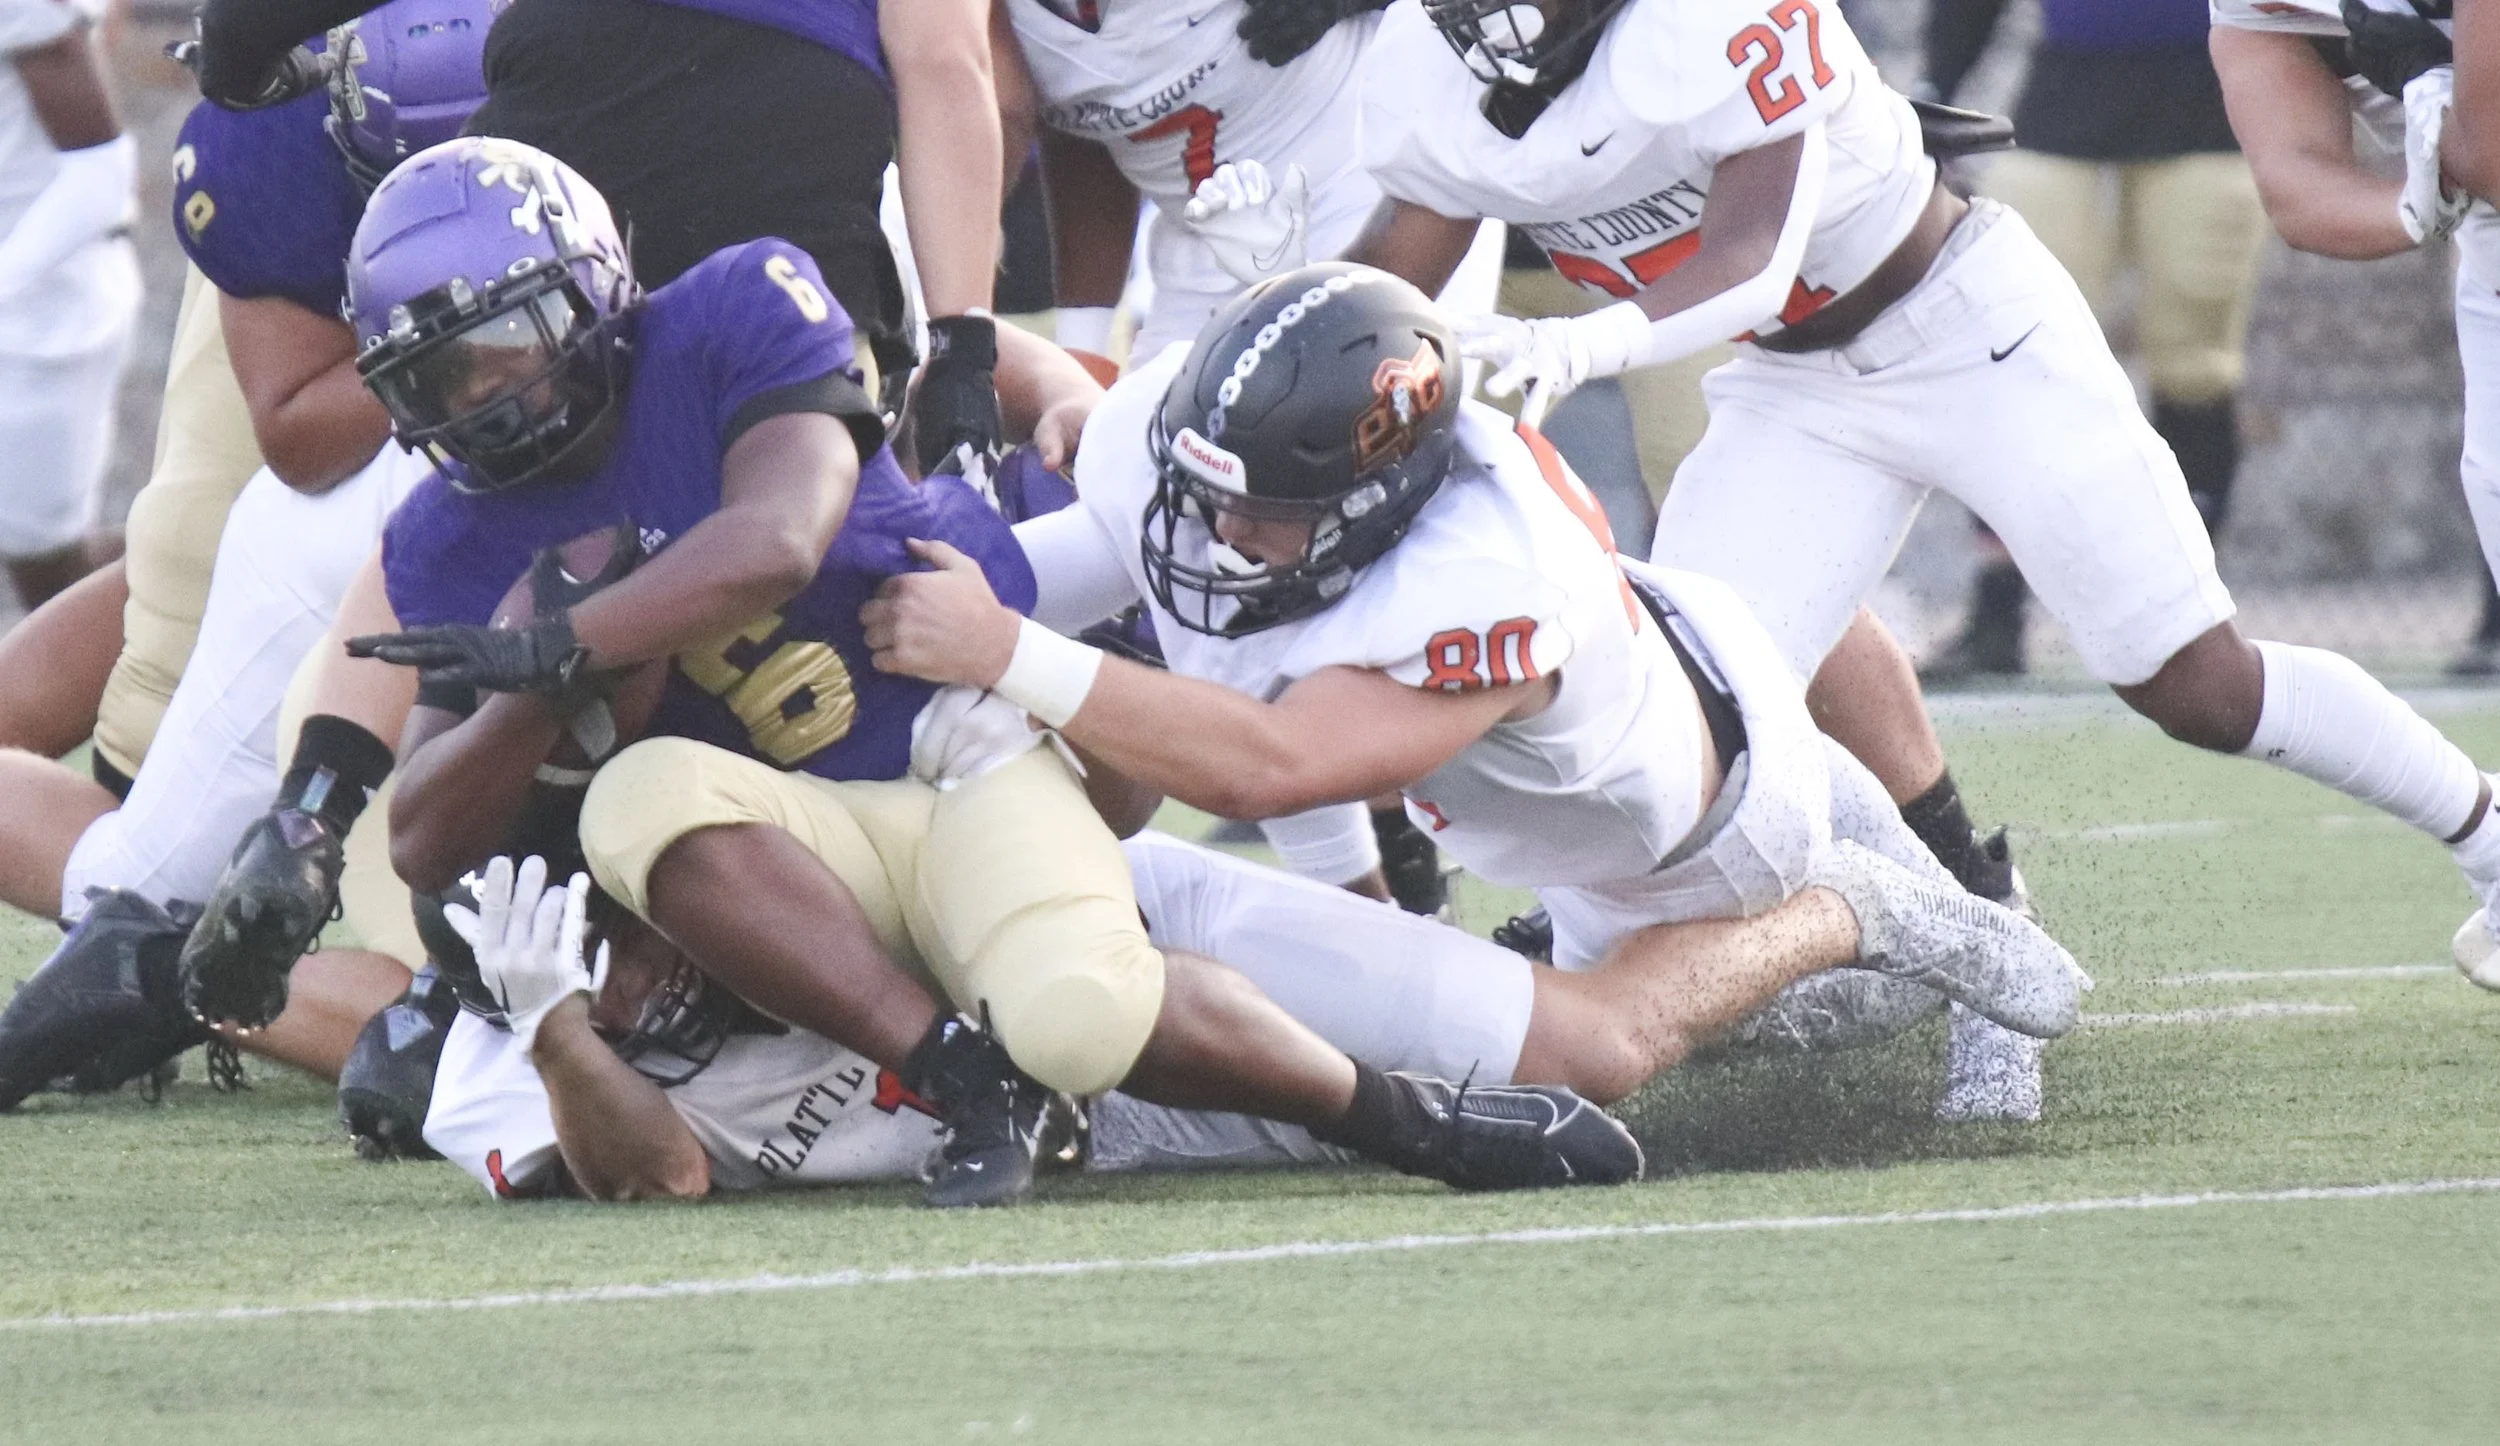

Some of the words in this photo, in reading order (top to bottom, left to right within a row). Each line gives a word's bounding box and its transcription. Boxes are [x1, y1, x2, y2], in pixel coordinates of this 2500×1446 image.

[1726, 0, 1836, 126] 27
[1126, 102, 1230, 196] 7
[1578, 178, 1707, 247] COUNTY
[764, 255, 828, 324] 6
[1181, 434, 1233, 474] Riddell
[678, 611, 857, 767] 6
[1422, 615, 1541, 690] 80
